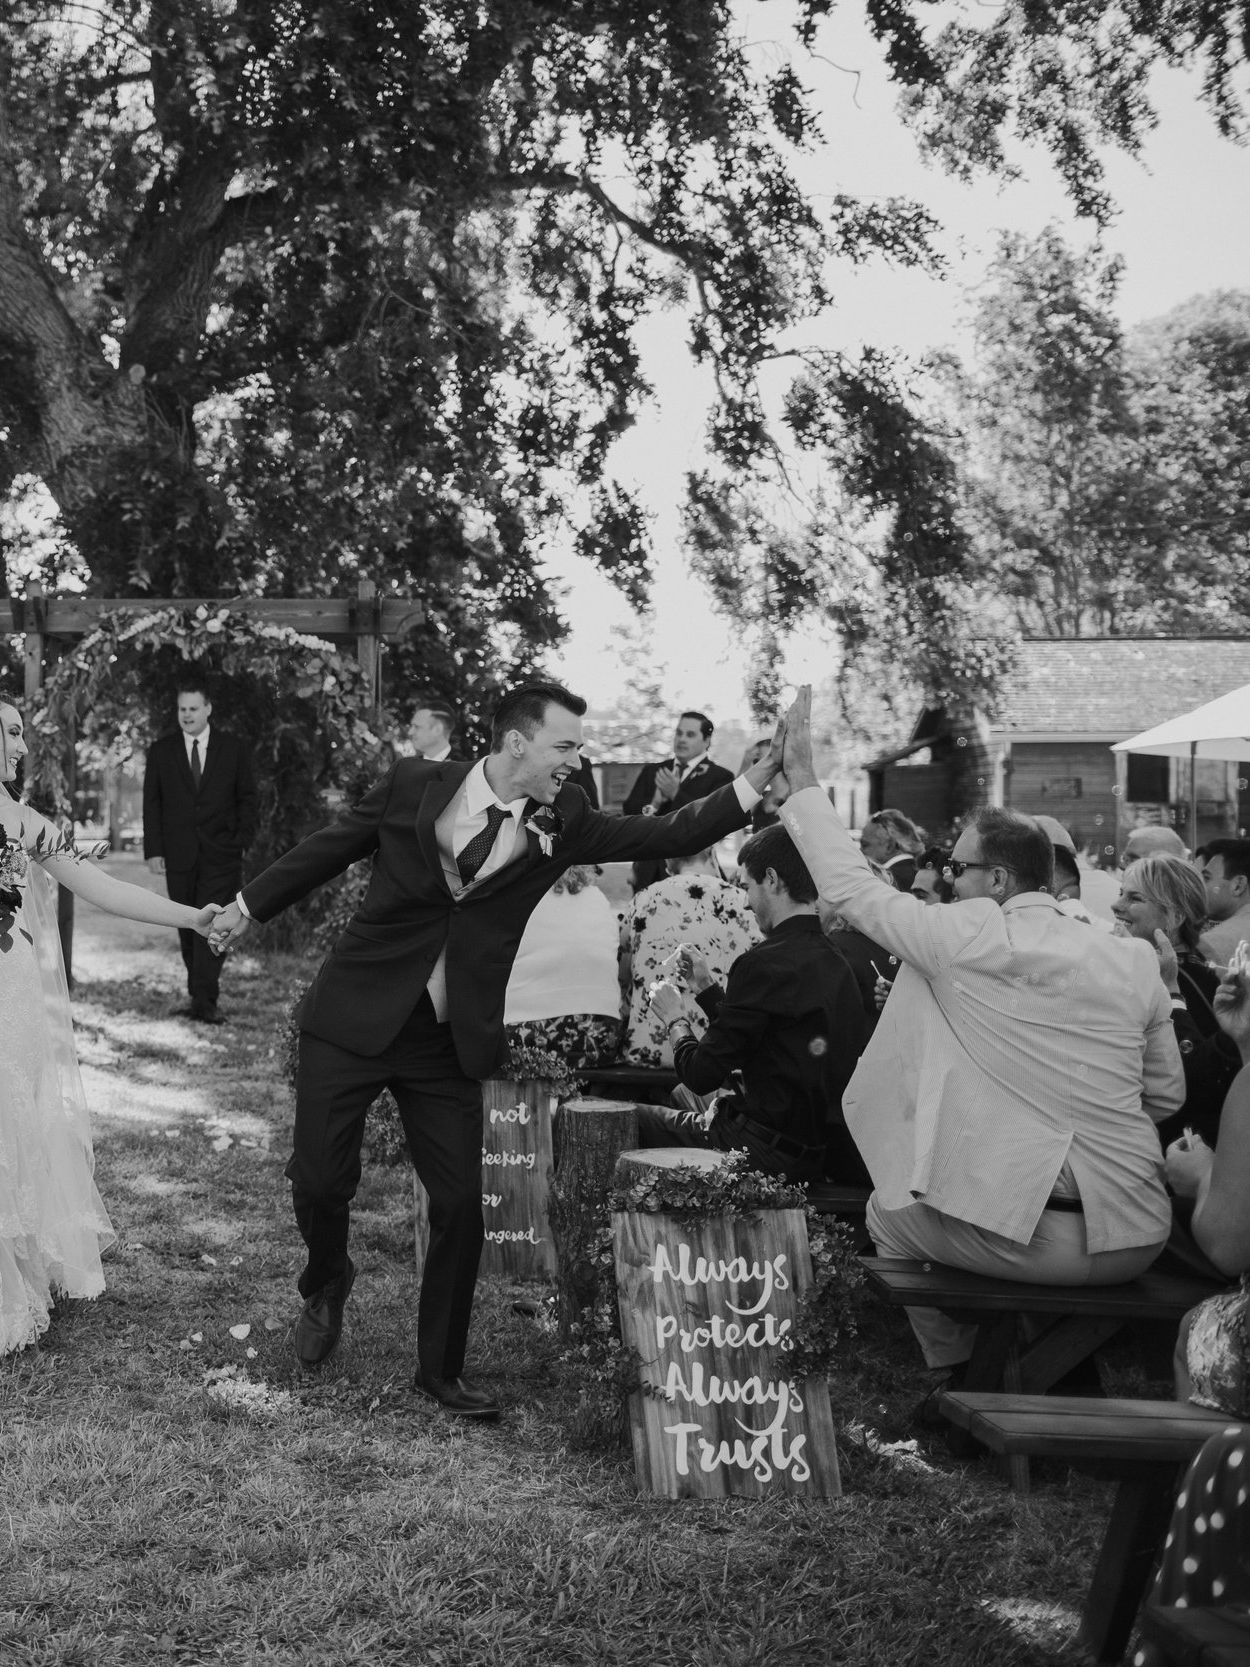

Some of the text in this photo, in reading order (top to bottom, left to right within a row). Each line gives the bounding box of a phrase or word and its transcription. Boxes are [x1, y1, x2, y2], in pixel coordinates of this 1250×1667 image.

[489, 1102, 531, 1125] not
[648, 1243, 789, 1315] Always
[656, 1313, 795, 1352] Protects
[660, 1361, 804, 1436] Always
[663, 1422, 811, 1483] Trusts
